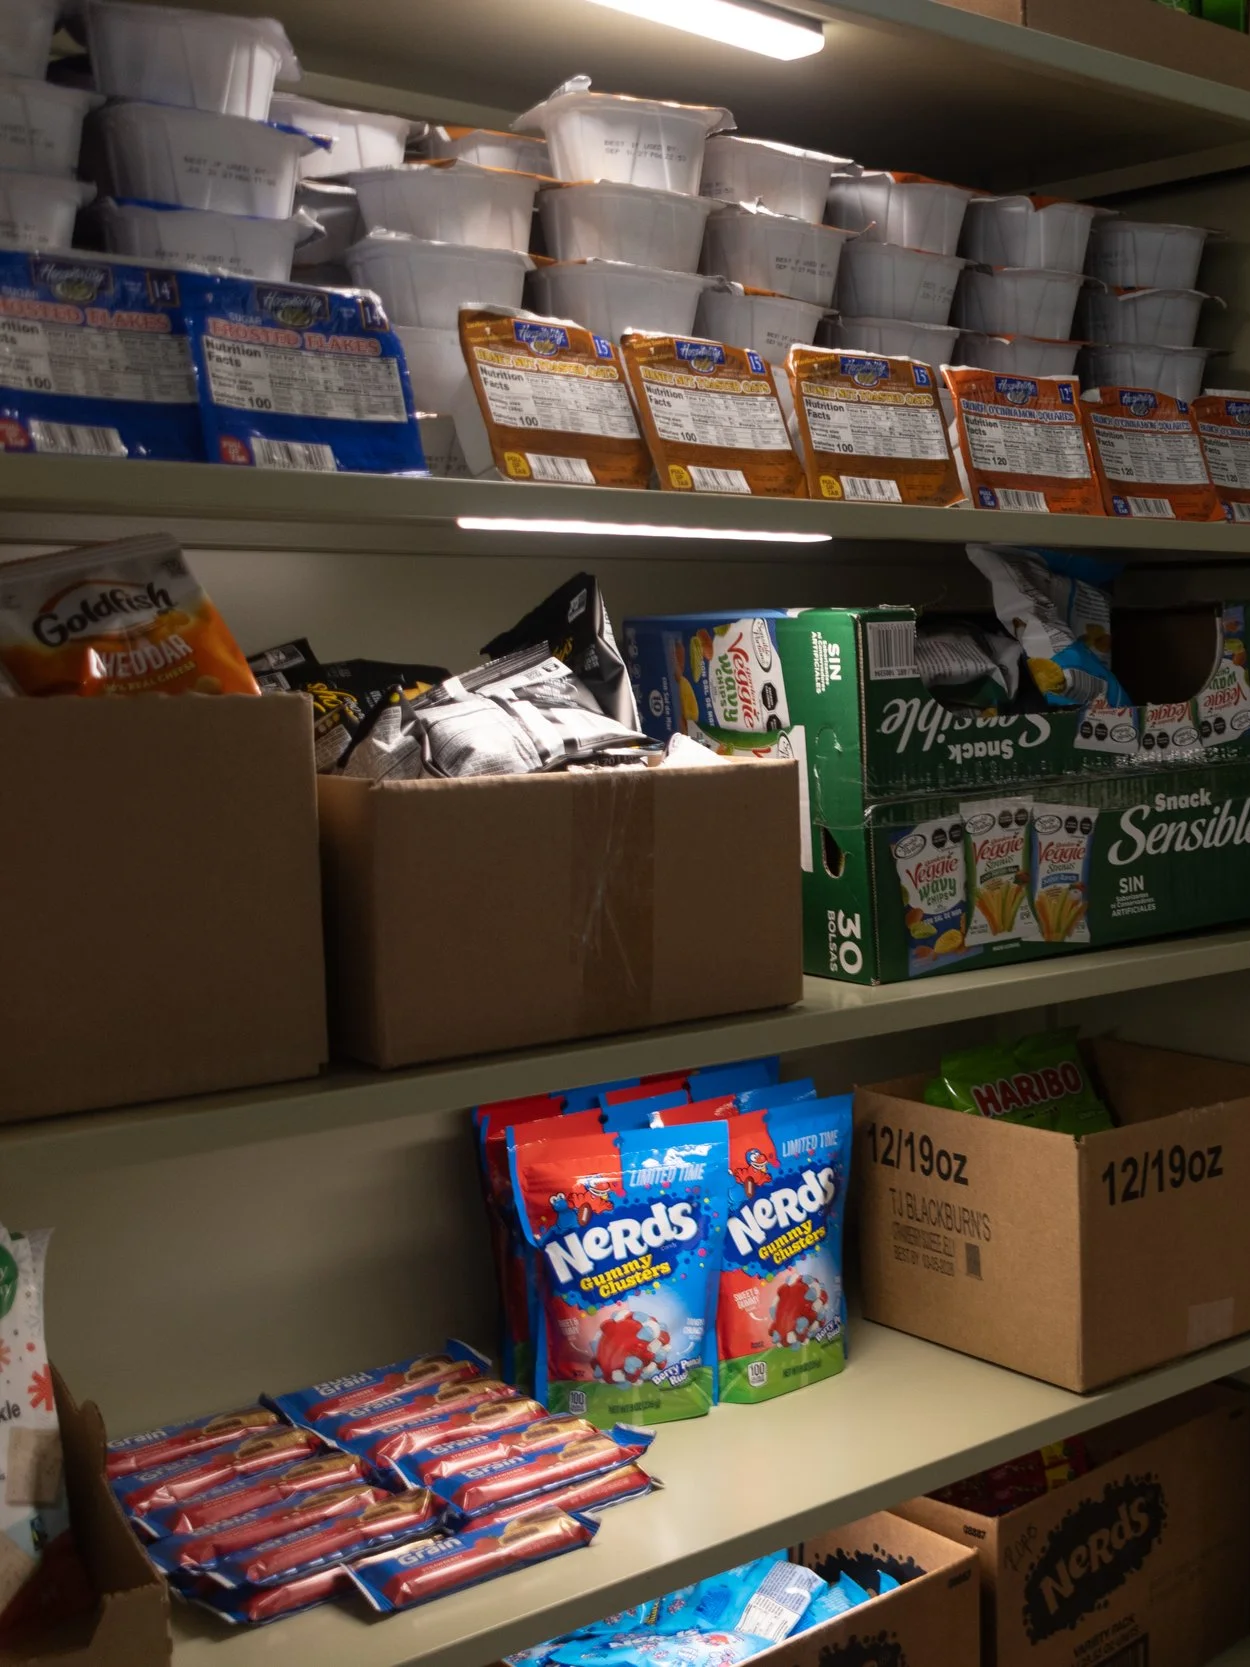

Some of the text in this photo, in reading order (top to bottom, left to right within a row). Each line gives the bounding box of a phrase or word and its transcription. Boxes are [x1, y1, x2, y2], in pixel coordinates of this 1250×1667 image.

[38, 262, 106, 284] Hospitality
[263, 290, 323, 314] Hospitality
[0, 299, 169, 331] ROSTED FLAKES
[228, 312, 263, 326] SUGAR
[0, 318, 41, 336] rition
[210, 318, 381, 356] FROSTED FLAKES
[518, 324, 566, 346] Hospitality
[205, 338, 263, 359] Nutrition
[680, 343, 722, 363] Hospitality
[207, 352, 242, 368] Facts
[844, 359, 887, 377] Hospitality
[26, 375, 52, 390] 100
[479, 366, 525, 382] Nutrition
[483, 379, 511, 392] Facts
[646, 385, 684, 400] Nutrition
[998, 378, 1035, 395] Hospitality
[247, 396, 272, 410] 100
[648, 395, 673, 408] Facts
[804, 398, 845, 412] Nutrition
[518, 416, 539, 427] 100
[806, 410, 831, 421] Facts
[965, 415, 999, 428] Nutrition
[1038, 411, 1075, 423] SQUARES
[680, 431, 698, 442] 100
[966, 425, 987, 436] Facts
[835, 443, 854, 453] 100
[991, 456, 1008, 466] 120
[31, 582, 176, 647] Goldfish
[157, 662, 197, 684] CHEESE
[811, 631, 822, 695] ARTIFICIALES
[827, 643, 842, 681] SIN
[715, 668, 728, 708] CHIPS
[718, 653, 739, 722] wavy
[727, 631, 755, 729] Veggie
[1202, 684, 1248, 710] Veggie
[947, 738, 1014, 764] Snack
[1154, 788, 1212, 813] Snack
[972, 836, 1025, 864] Veggie
[1038, 842, 1087, 864] Veggie
[905, 857, 959, 888] Veggie
[918, 876, 957, 903] wavy
[1118, 874, 1145, 894] SIN
[926, 893, 949, 907] CHIPS
[1111, 903, 1157, 918] ARTIFICIALES
[826, 909, 839, 974] BOLSAS
[836, 911, 863, 976] 30
[970, 1060, 1083, 1118] HARIBO
[781, 1129, 839, 1159] LIMITED TIME
[866, 1121, 969, 1187] 12/19oz
[628, 1162, 706, 1188] LIMITED TIME
[1102, 1144, 1224, 1207] 12/19oz
[888, 1187, 904, 1218] TJ
[905, 1191, 992, 1243] BLACKBURN'S
[757, 1218, 813, 1261] Gummy
[771, 1226, 827, 1265] Clusters
[579, 1253, 653, 1292] Gummy
[599, 1259, 672, 1300] Clusters
[650, 1362, 681, 1386] Berry
[749, 1363, 765, 1376] 100
[318, 1371, 375, 1398] Grain
[347, 1394, 403, 1418] Grain
[569, 1391, 585, 1405] 100
[106, 1427, 168, 1449] Grain
[426, 1434, 489, 1456] Grain
[464, 1455, 526, 1480] Grain
[398, 1537, 463, 1567] Grain
